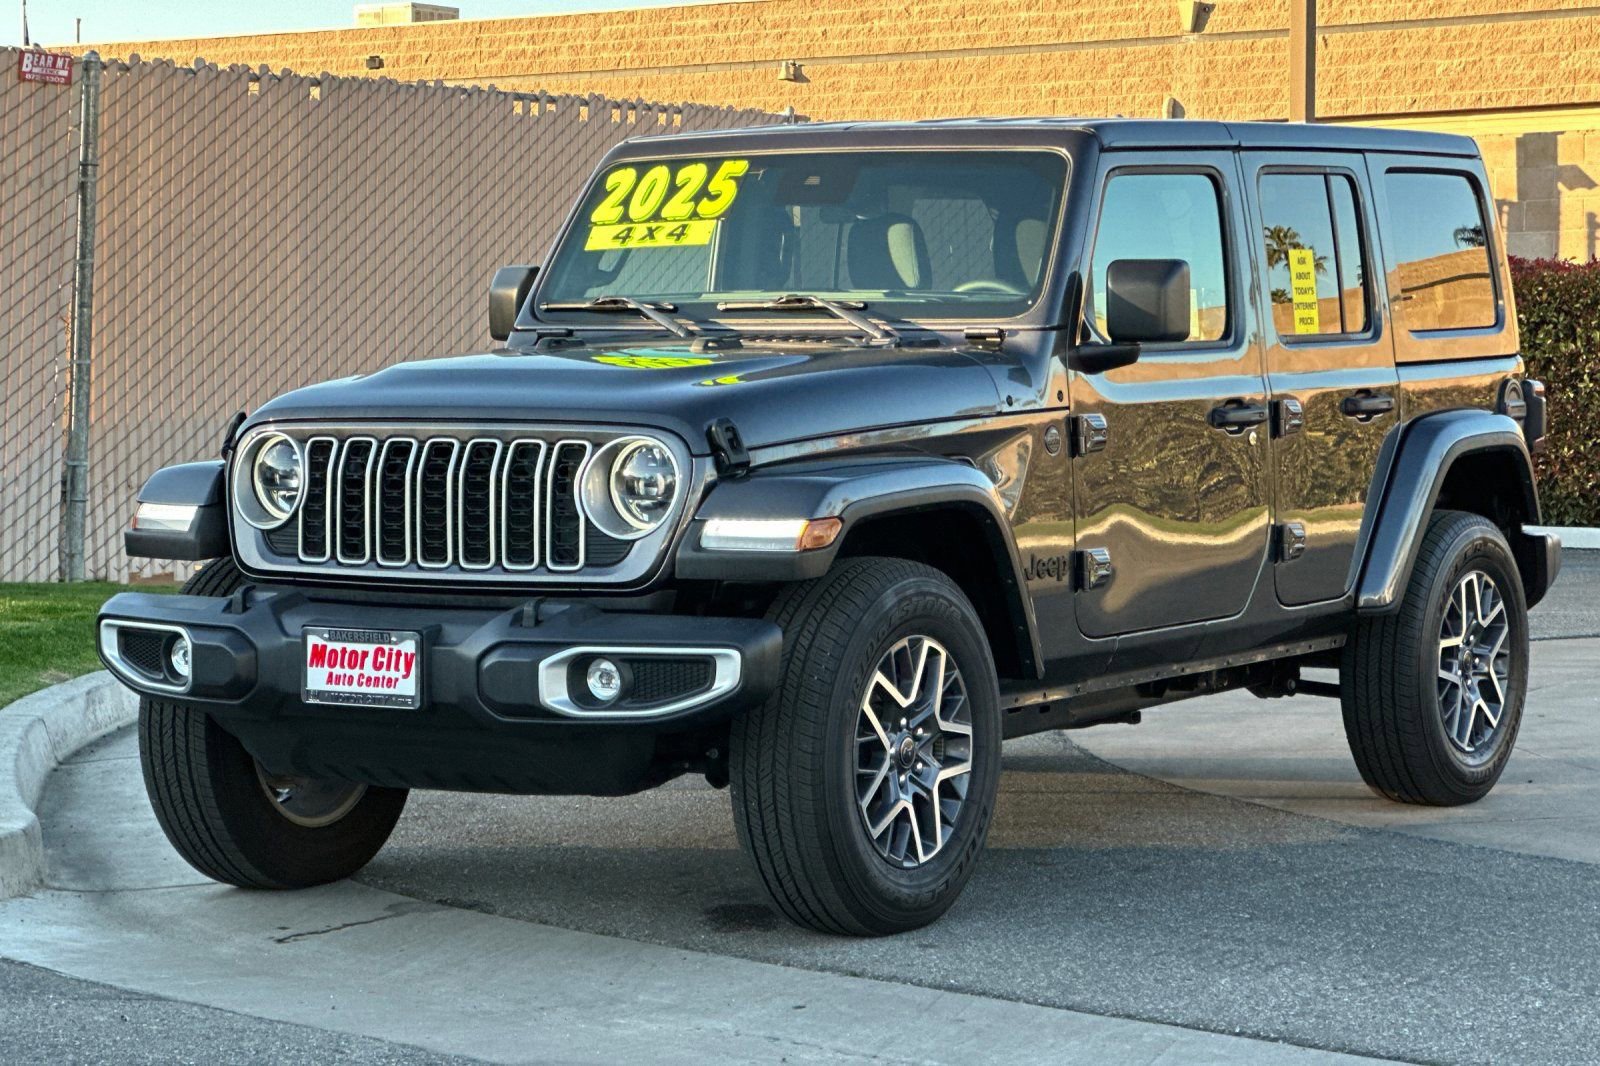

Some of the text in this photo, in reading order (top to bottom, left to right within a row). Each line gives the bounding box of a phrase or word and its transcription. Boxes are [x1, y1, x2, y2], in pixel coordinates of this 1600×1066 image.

[22, 52, 54, 72] BEAR
[590, 160, 749, 225] 2025
[1297, 257, 1306, 265] ASK
[1295, 272, 1311, 280] ABOUT
[1295, 287, 1315, 296] TODAY'S
[1294, 302, 1316, 311] INTERNET
[1024, 553, 1069, 582] Jeep
[328, 630, 391, 643] BAKERSFIELD
[309, 643, 416, 680] Motor City
[326, 671, 400, 689] Auto Center
